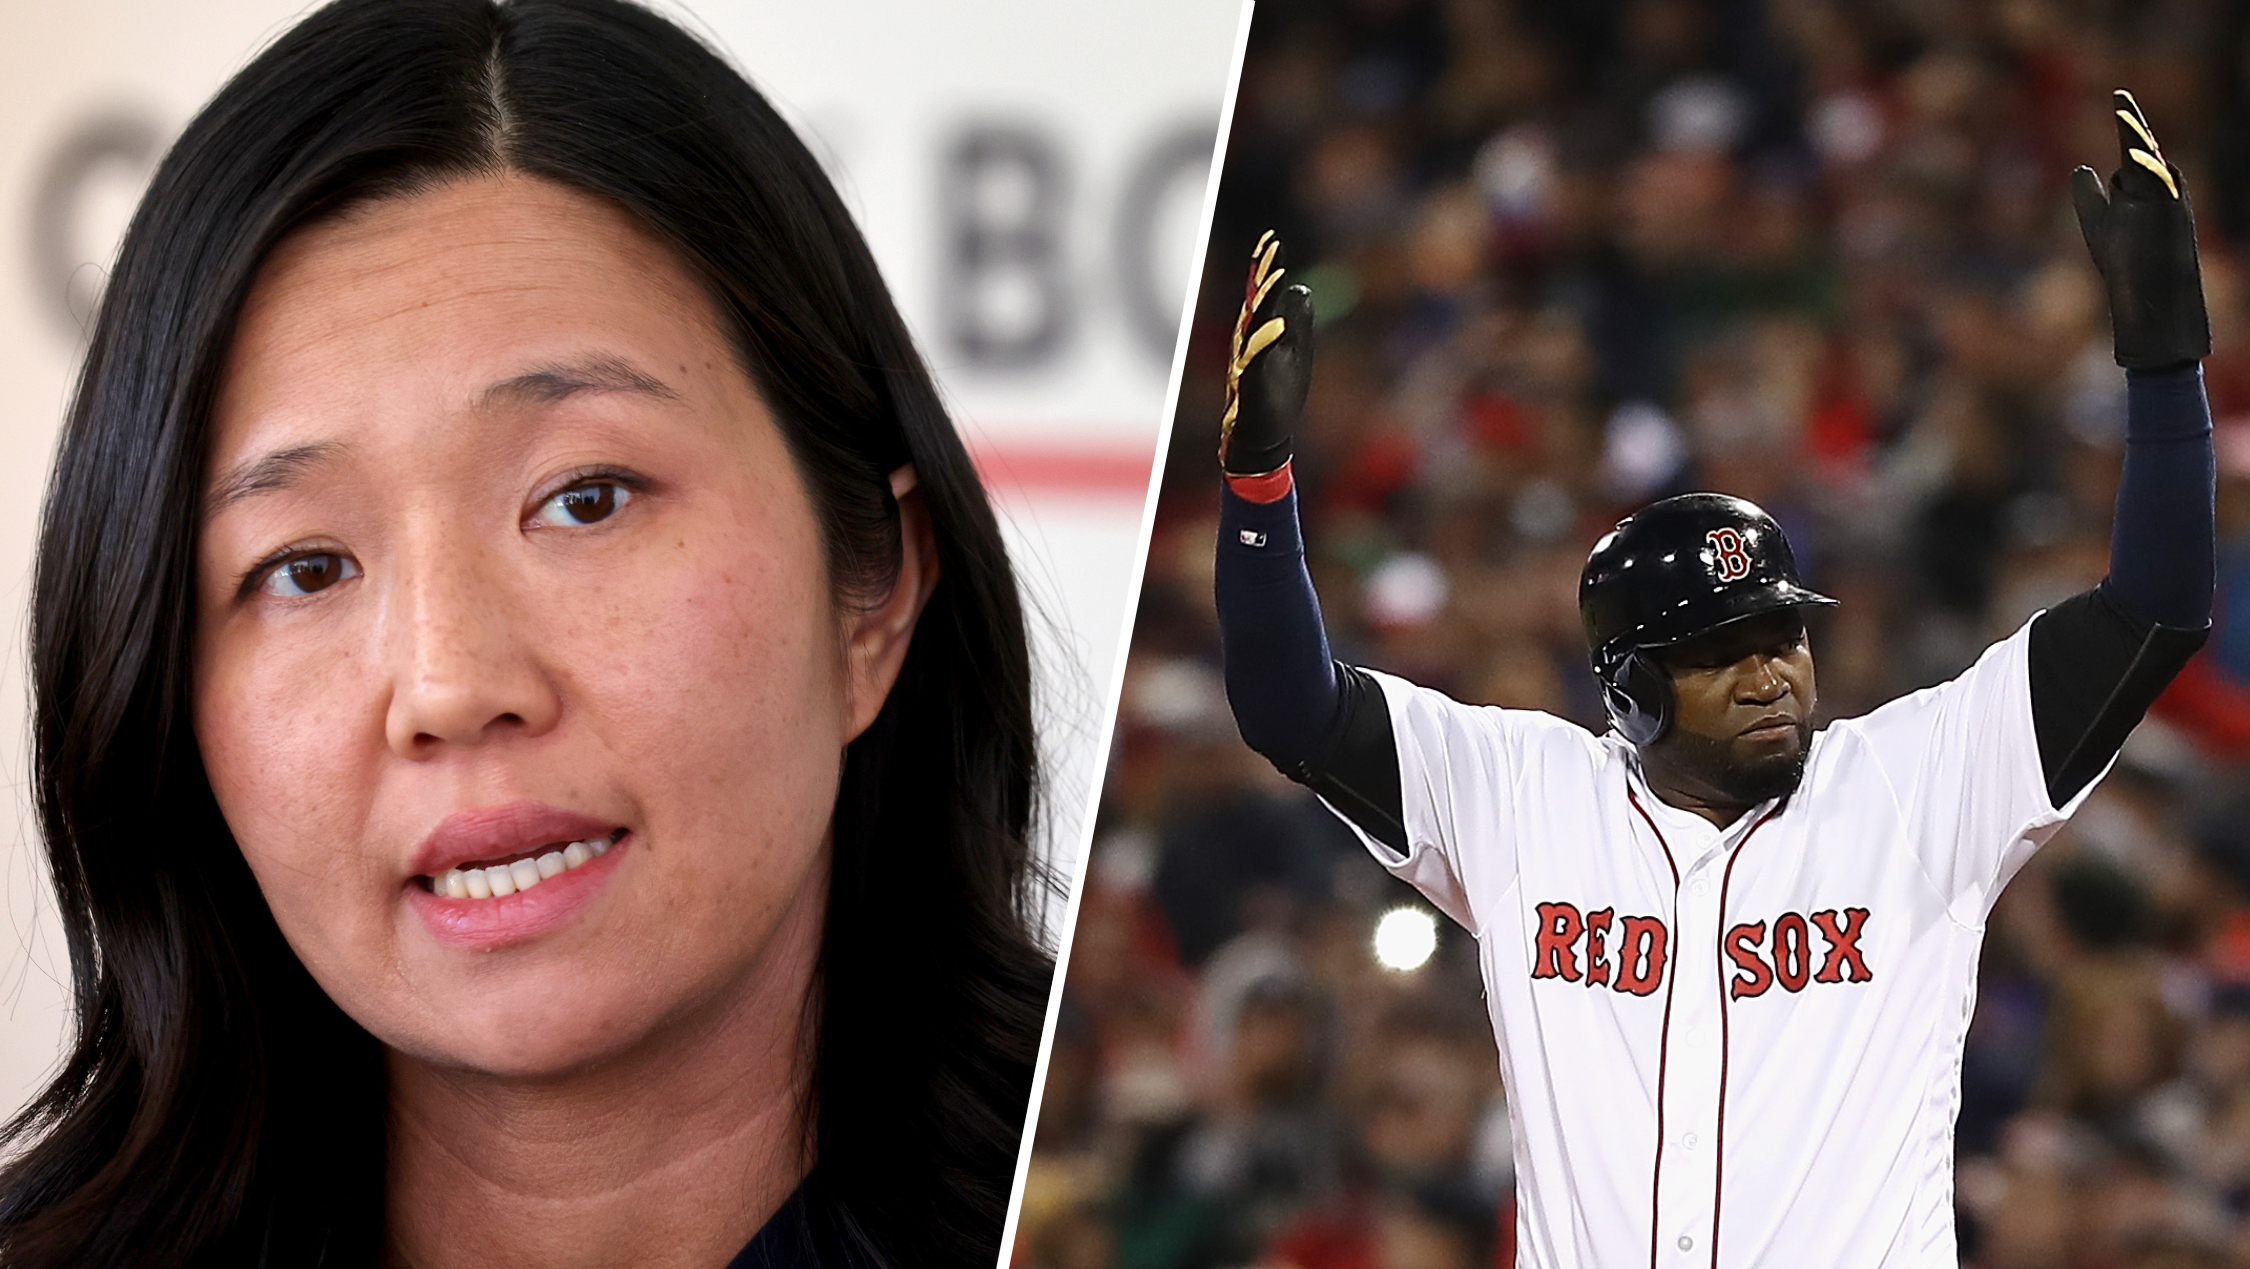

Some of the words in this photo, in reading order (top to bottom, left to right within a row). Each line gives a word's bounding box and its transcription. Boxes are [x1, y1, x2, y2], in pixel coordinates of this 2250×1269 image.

[1706, 527, 1753, 582] B
[1531, 902, 1667, 996] RED
[1724, 908, 1873, 1002] SOX
